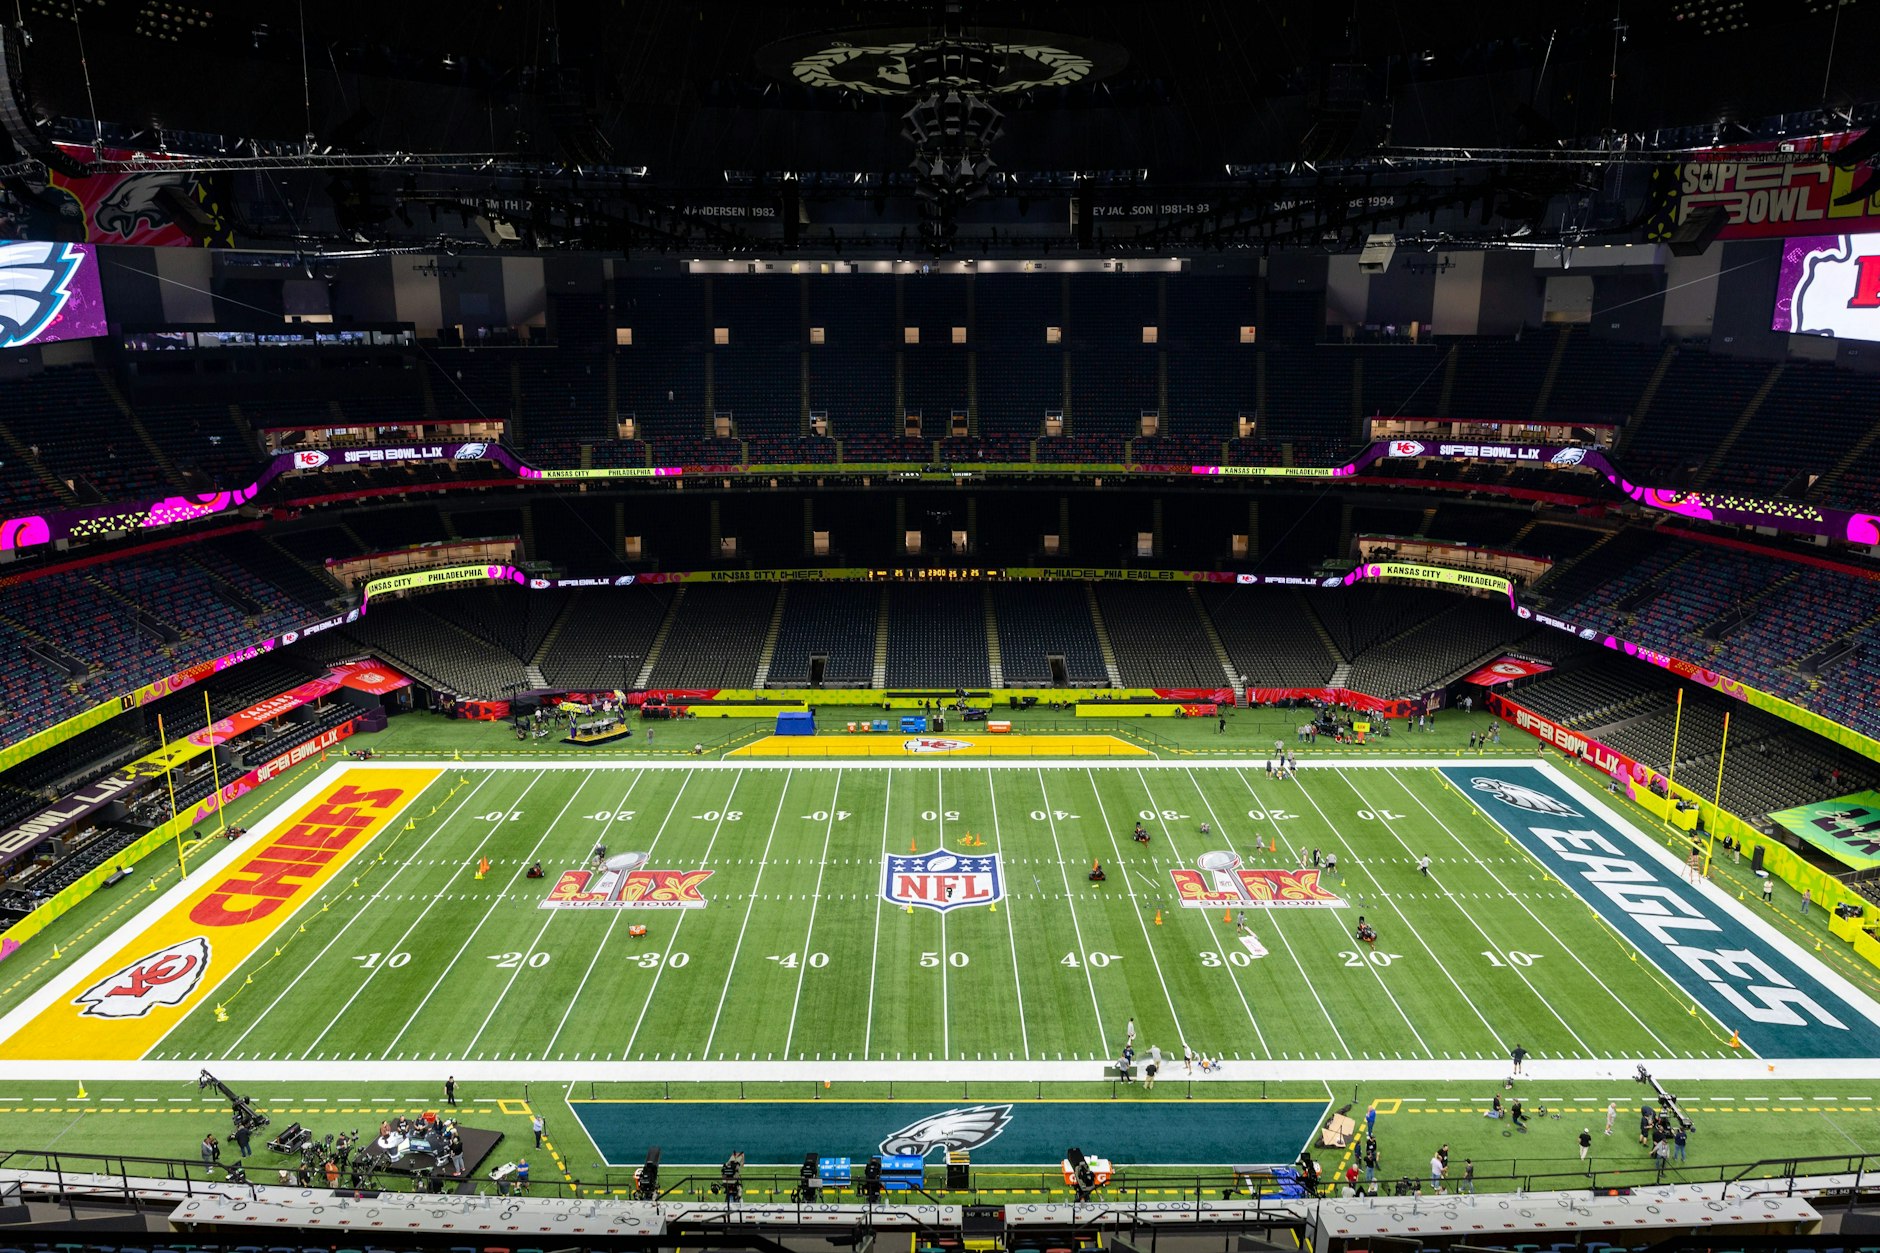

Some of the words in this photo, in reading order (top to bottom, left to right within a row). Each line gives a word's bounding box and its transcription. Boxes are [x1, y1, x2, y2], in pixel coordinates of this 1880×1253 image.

[752, 208, 775, 217] 1982
[1107, 206, 1153, 216] JACSON
[1678, 186, 1823, 225] BOWL
[345, 450, 384, 462] SUPER
[385, 448, 421, 460] BOWL
[422, 447, 442, 458] LIX
[1440, 445, 1479, 456] SUPER
[1480, 446, 1517, 458] BOWL
[1518, 448, 1540, 460] LIX
[1285, 468, 1329, 476] PHILADELPHIA
[368, 580, 392, 592] KANSAS
[394, 577, 412, 588] CITY
[428, 569, 483, 581] PHILADELPHIA
[711, 571, 750, 579] KANSAS
[754, 571, 775, 579] CITY
[780, 570, 823, 579] CHIEFS
[1043, 570, 1122, 579] PHILADELPHIA
[1127, 571, 1174, 579] EAGLES
[1387, 566, 1420, 576] KANSAS
[1422, 569, 1441, 578] CITY
[1457, 574, 1507, 590] PHILADELPHIA
[239, 694, 294, 719] CAESARS
[253, 698, 303, 721] SUPERDOME
[1516, 709, 1554, 738] SUPER
[1555, 728, 1593, 762] BOWL
[1594, 748, 1619, 774] LIX
[257, 759, 290, 782] SUPER
[291, 740, 321, 764] BOWL
[321, 729, 338, 748] LIX
[0, 804, 90, 853] BOWL
[73, 777, 134, 803] LIX
[486, 811, 525, 822] 10
[594, 811, 636, 822] 20
[703, 811, 743, 822] 30
[812, 811, 852, 822] 40
[921, 810, 960, 821] 50
[1030, 810, 1070, 821] 40
[1139, 810, 1180, 821] 30
[1248, 810, 1289, 820] 20
[1356, 810, 1397, 820] 10
[189, 785, 405, 927] CHIEFS
[897, 875, 989, 902] NFL
[1528, 827, 1850, 1031] EAGLES
[360, 952, 411, 969] 10
[496, 952, 551, 969] 20
[638, 952, 690, 969] 30
[778, 952, 830, 969] 40
[919, 952, 969, 968] 50
[1060, 951, 1110, 968] 40
[1200, 951, 1250, 967] 30
[1338, 951, 1391, 967] 20
[1480, 951, 1533, 967] 10
